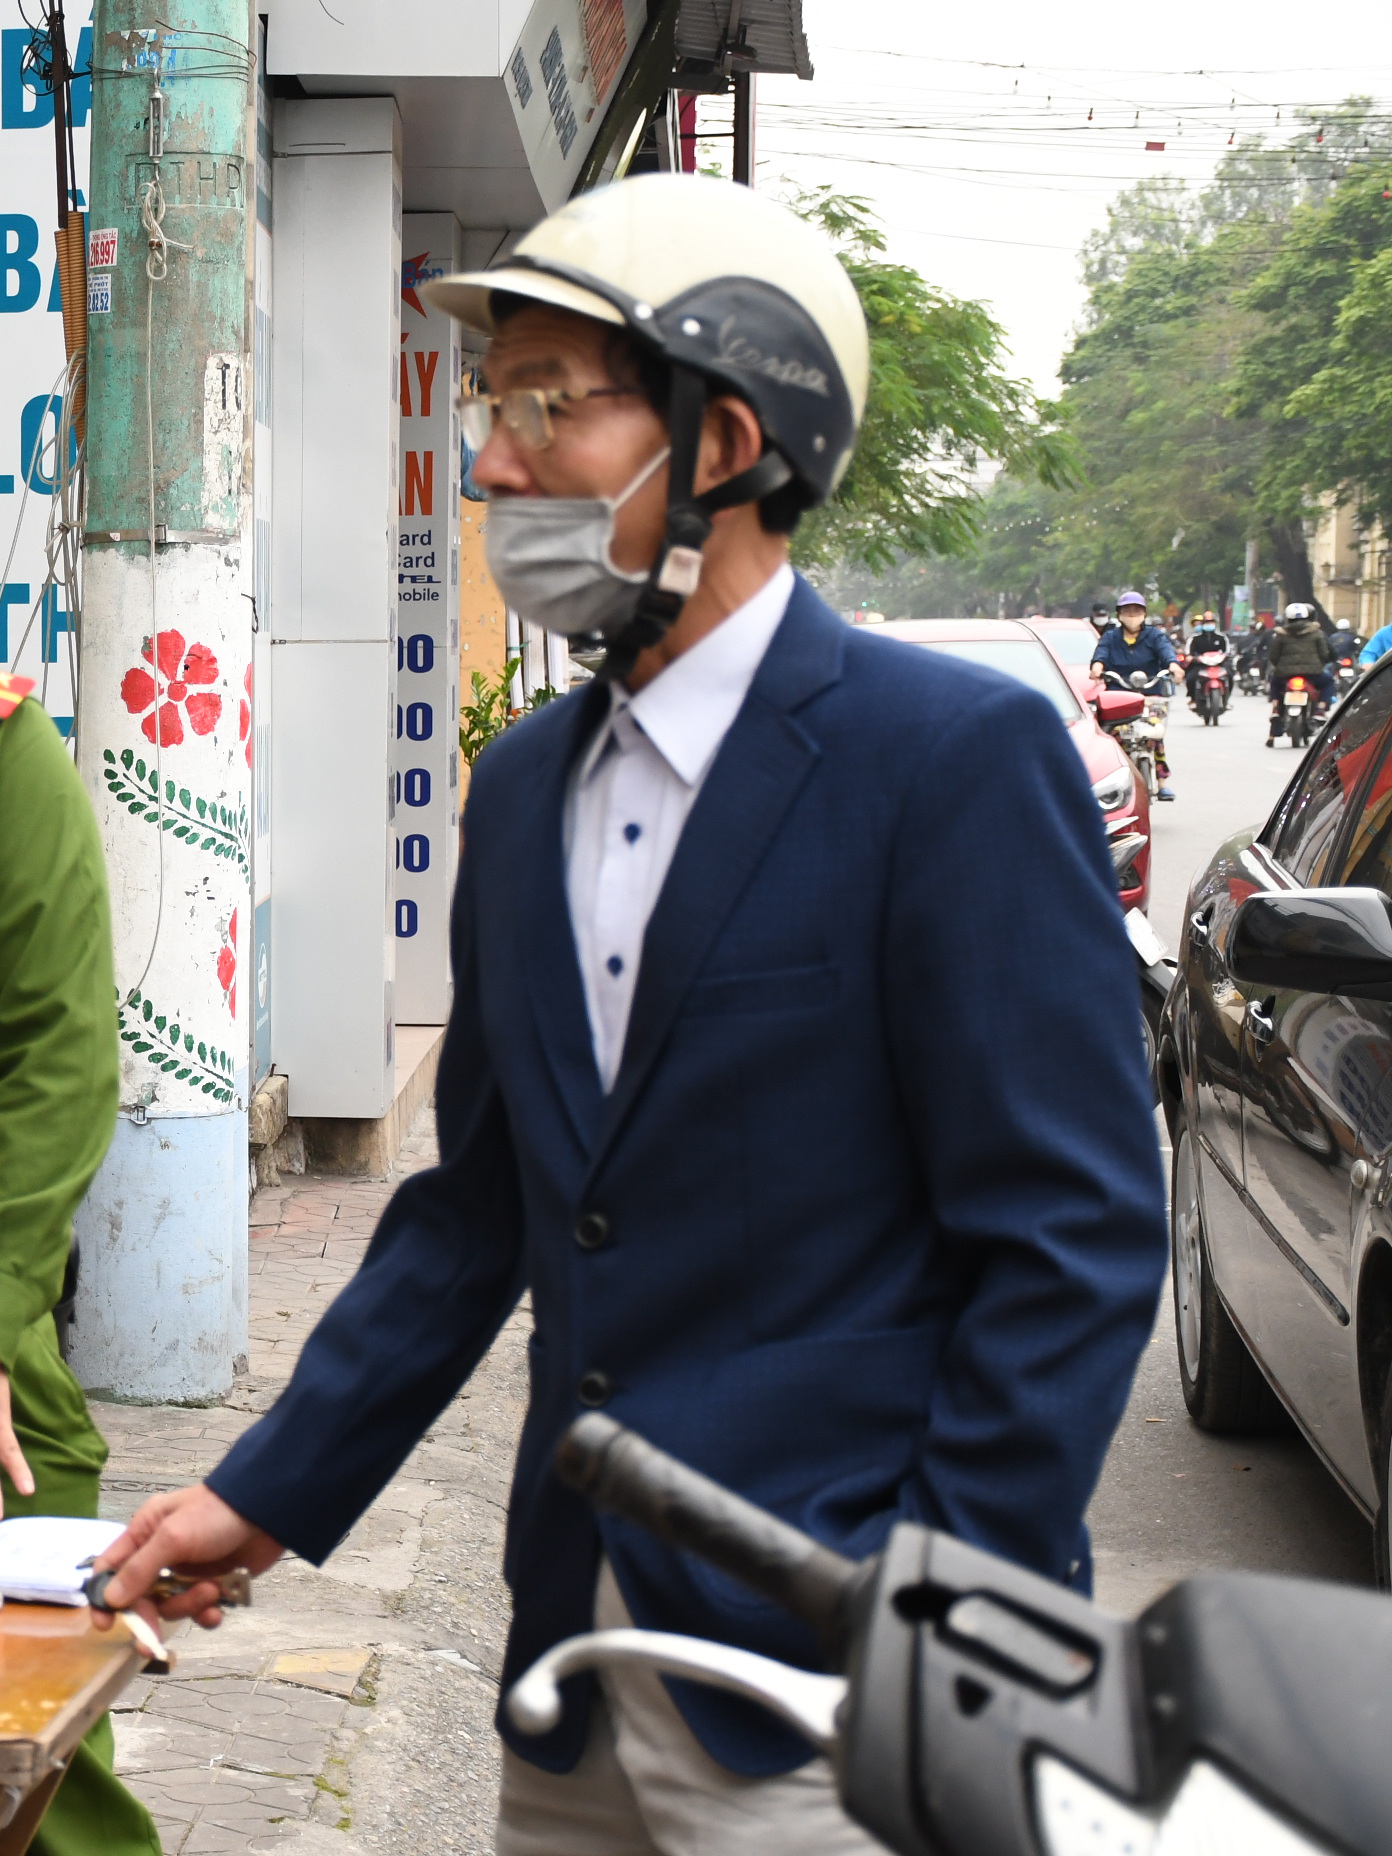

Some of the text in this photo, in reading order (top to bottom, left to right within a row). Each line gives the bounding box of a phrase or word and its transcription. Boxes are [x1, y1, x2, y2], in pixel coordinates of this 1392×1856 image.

[399, 451, 434, 516] N
[398, 552, 435, 569] ard
[397, 634, 434, 673] 0
[397, 702, 433, 741] 0
[396, 768, 431, 807] 0
[396, 834, 429, 873] 0
